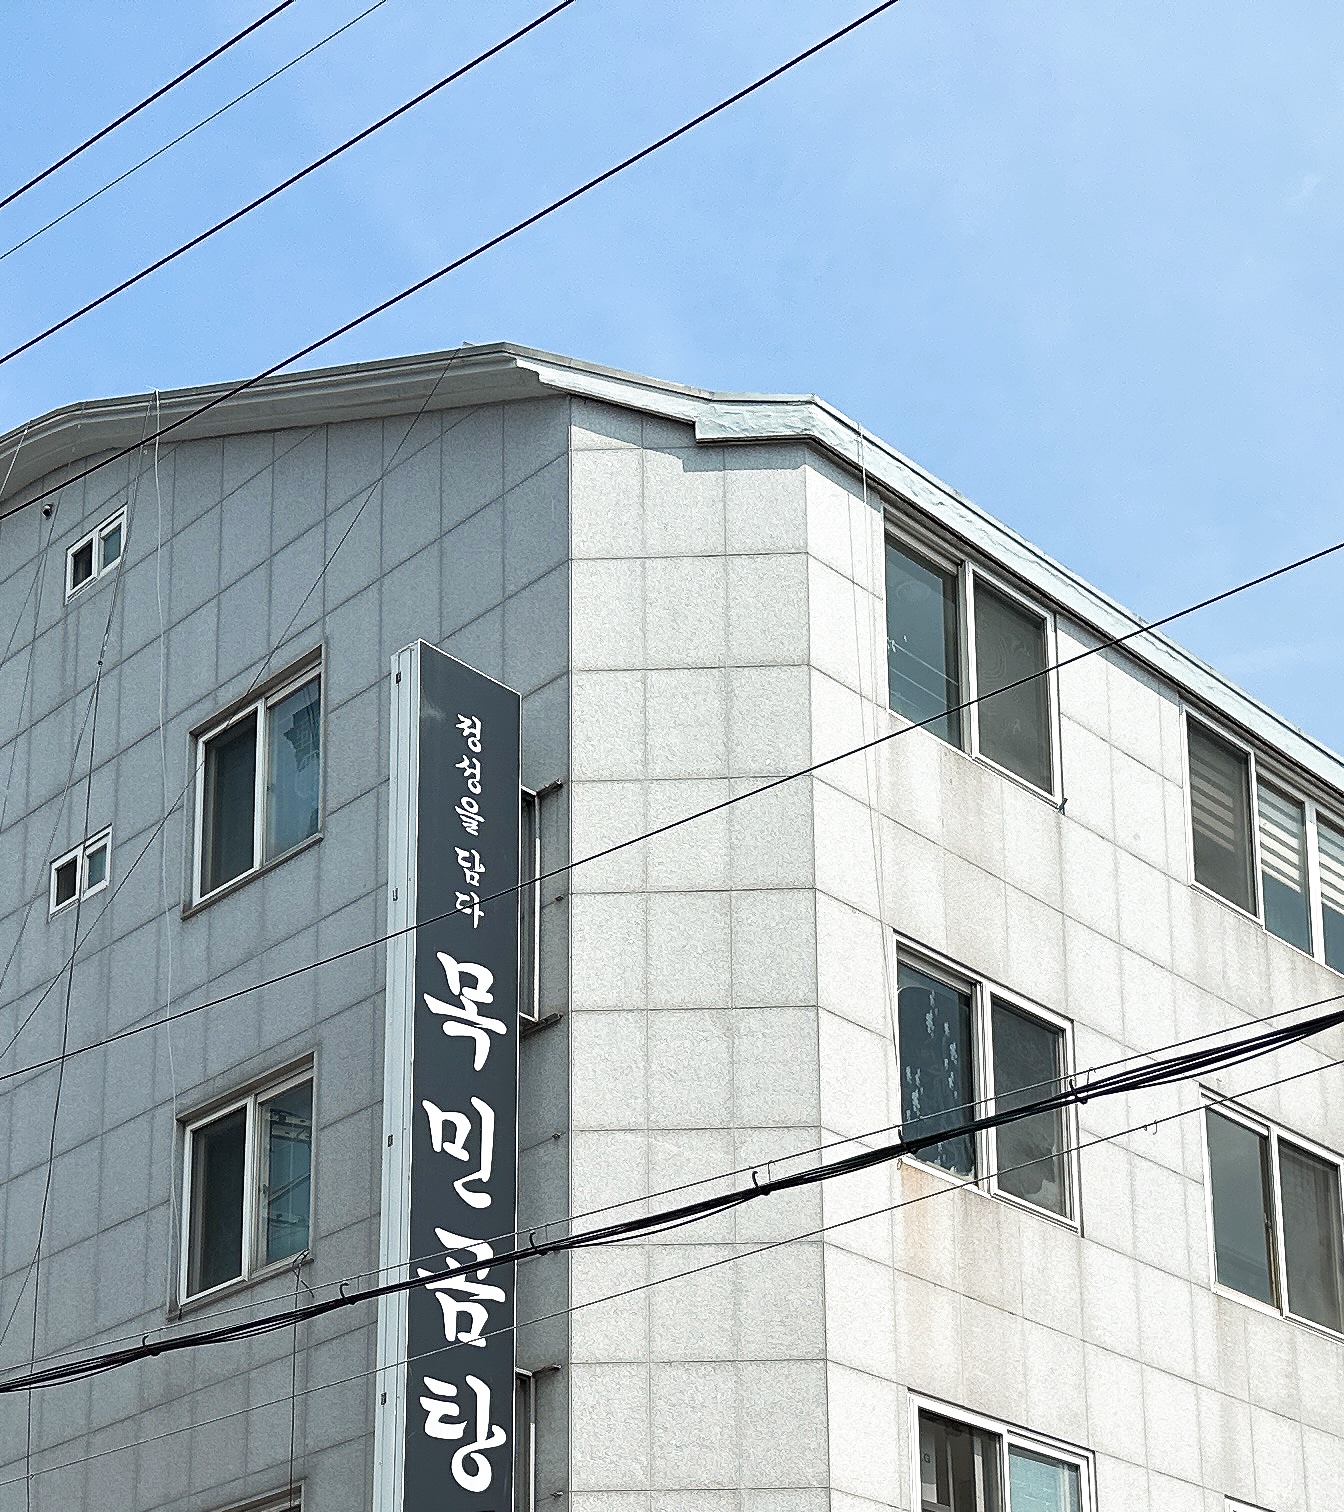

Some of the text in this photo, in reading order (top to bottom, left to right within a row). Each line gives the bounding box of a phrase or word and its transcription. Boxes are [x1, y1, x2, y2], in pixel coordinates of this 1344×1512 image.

[455, 714, 485, 928] 정성을 담다
[417, 951, 508, 1492] 목민곰탕
